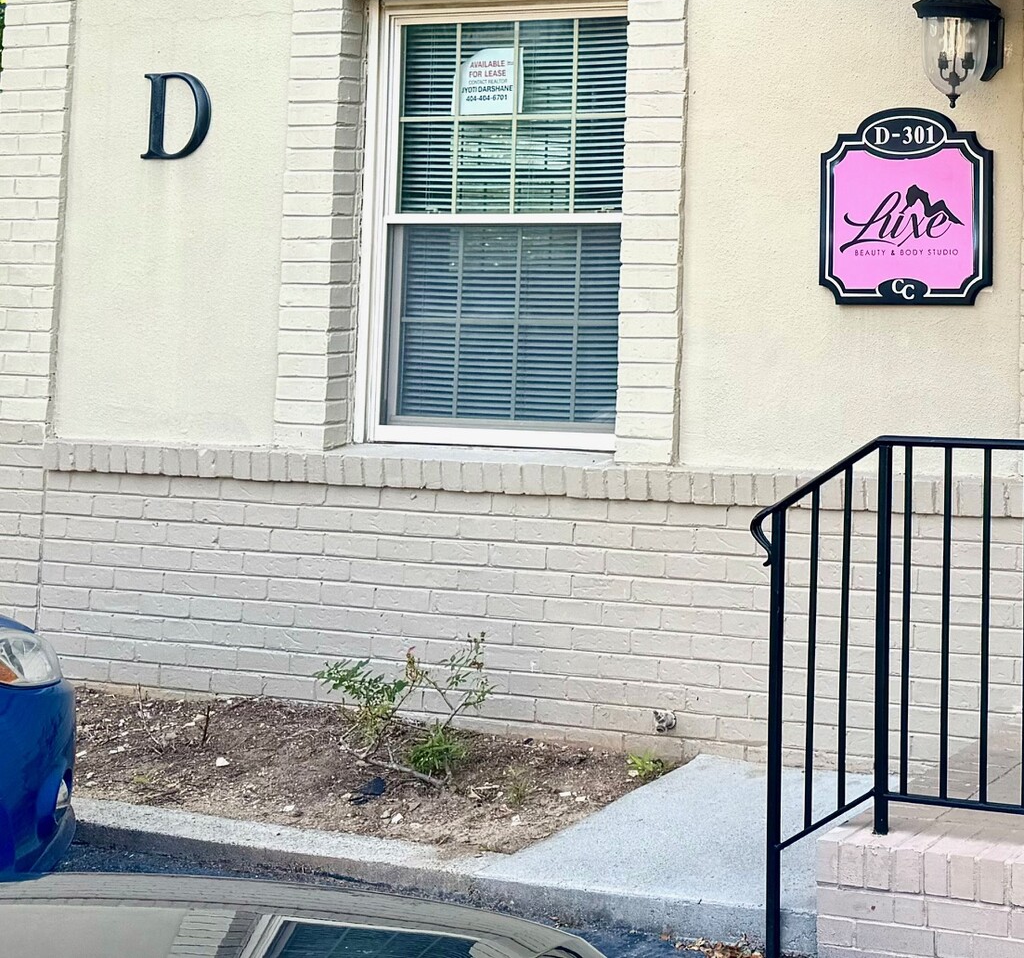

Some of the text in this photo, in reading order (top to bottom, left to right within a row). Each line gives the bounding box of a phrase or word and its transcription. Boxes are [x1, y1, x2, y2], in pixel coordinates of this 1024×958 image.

[469, 60, 505, 69] AVAILABLE
[484, 70, 506, 78] LEASE
[461, 86, 477, 94] JYOTI
[465, 94, 508, 102] 404-404-6701
[140, 72, 212, 160] D
[874, 125, 936, 145] D-301
[839, 191, 953, 253] Luxe
[927, 248, 959, 256] STUDIO
